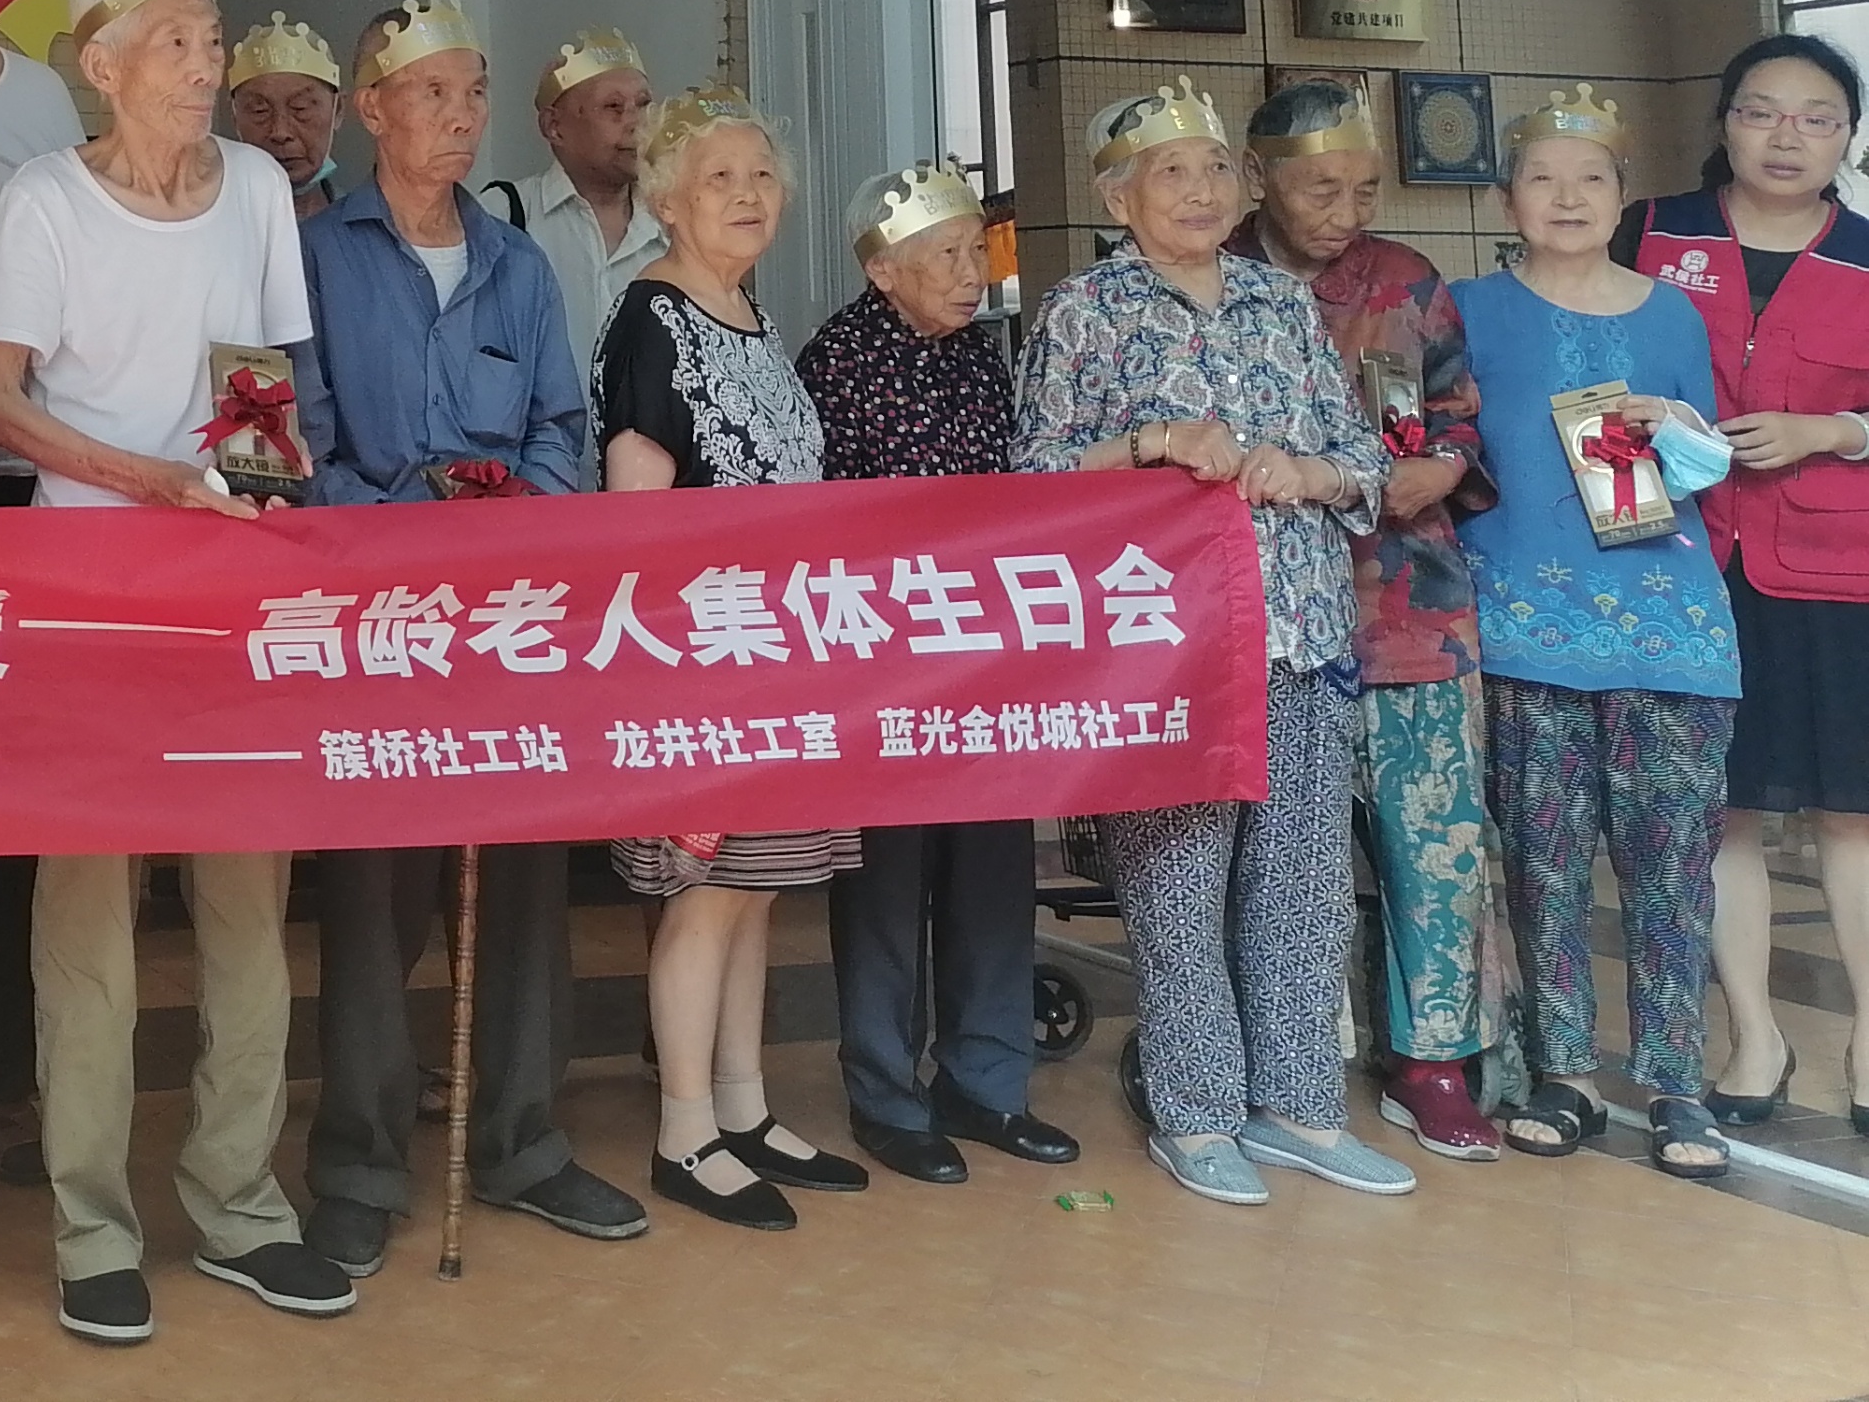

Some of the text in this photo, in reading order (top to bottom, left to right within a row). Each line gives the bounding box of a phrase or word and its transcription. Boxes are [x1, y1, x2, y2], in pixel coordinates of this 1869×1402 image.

[1330, 11, 1405, 29] 党建共建项目
[1658, 263, 1721, 289] 武侯社工
[226, 455, 270, 473] 放大镜
[605, 710, 843, 770] 龙井社工室
[875, 696, 1190, 759] 蓝光金悦城社工点
